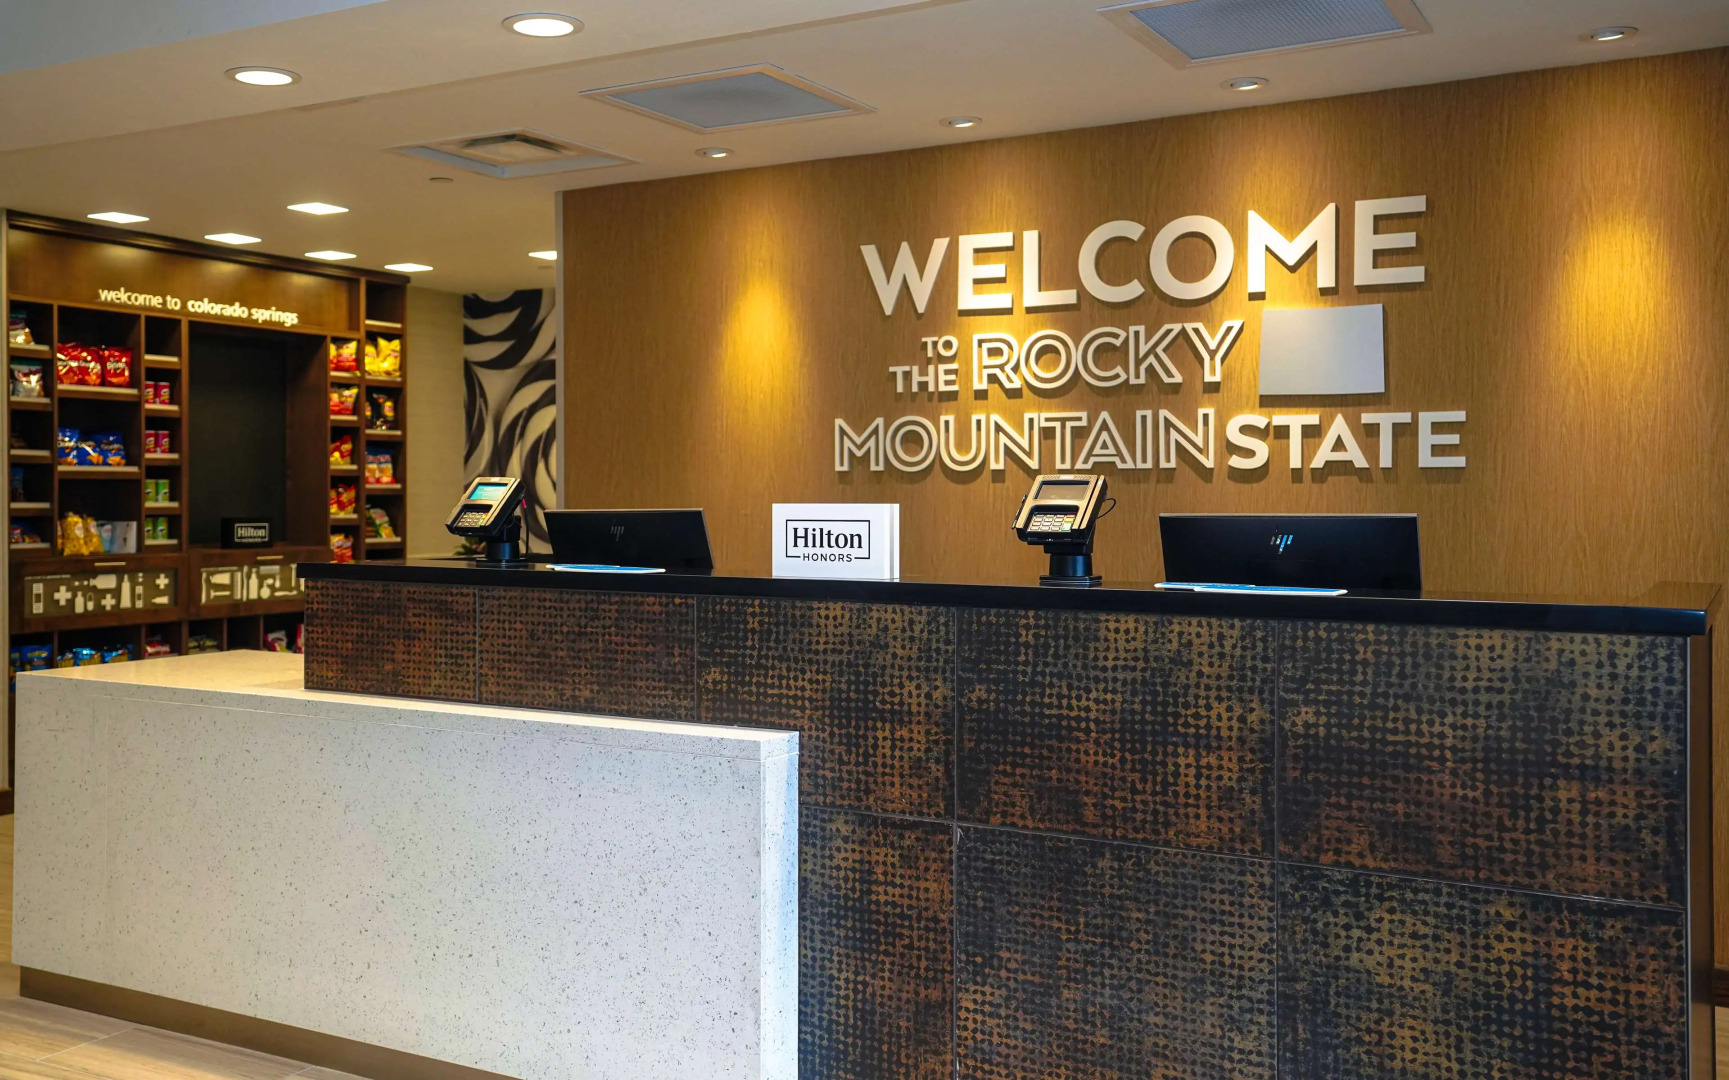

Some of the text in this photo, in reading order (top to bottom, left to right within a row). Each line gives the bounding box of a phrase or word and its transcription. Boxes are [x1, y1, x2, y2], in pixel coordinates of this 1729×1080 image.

[860, 195, 1427, 316] WELCOME
[99, 287, 298, 327] welcome to colorado springs
[889, 319, 1244, 392] THE ROCKY
[922, 335, 958, 358] TO
[835, 408, 1467, 472] MOUNTAIN STATE
[237, 526, 266, 537] Hilton
[792, 527, 863, 549] Hilton
[802, 553, 853, 562] HONORS
